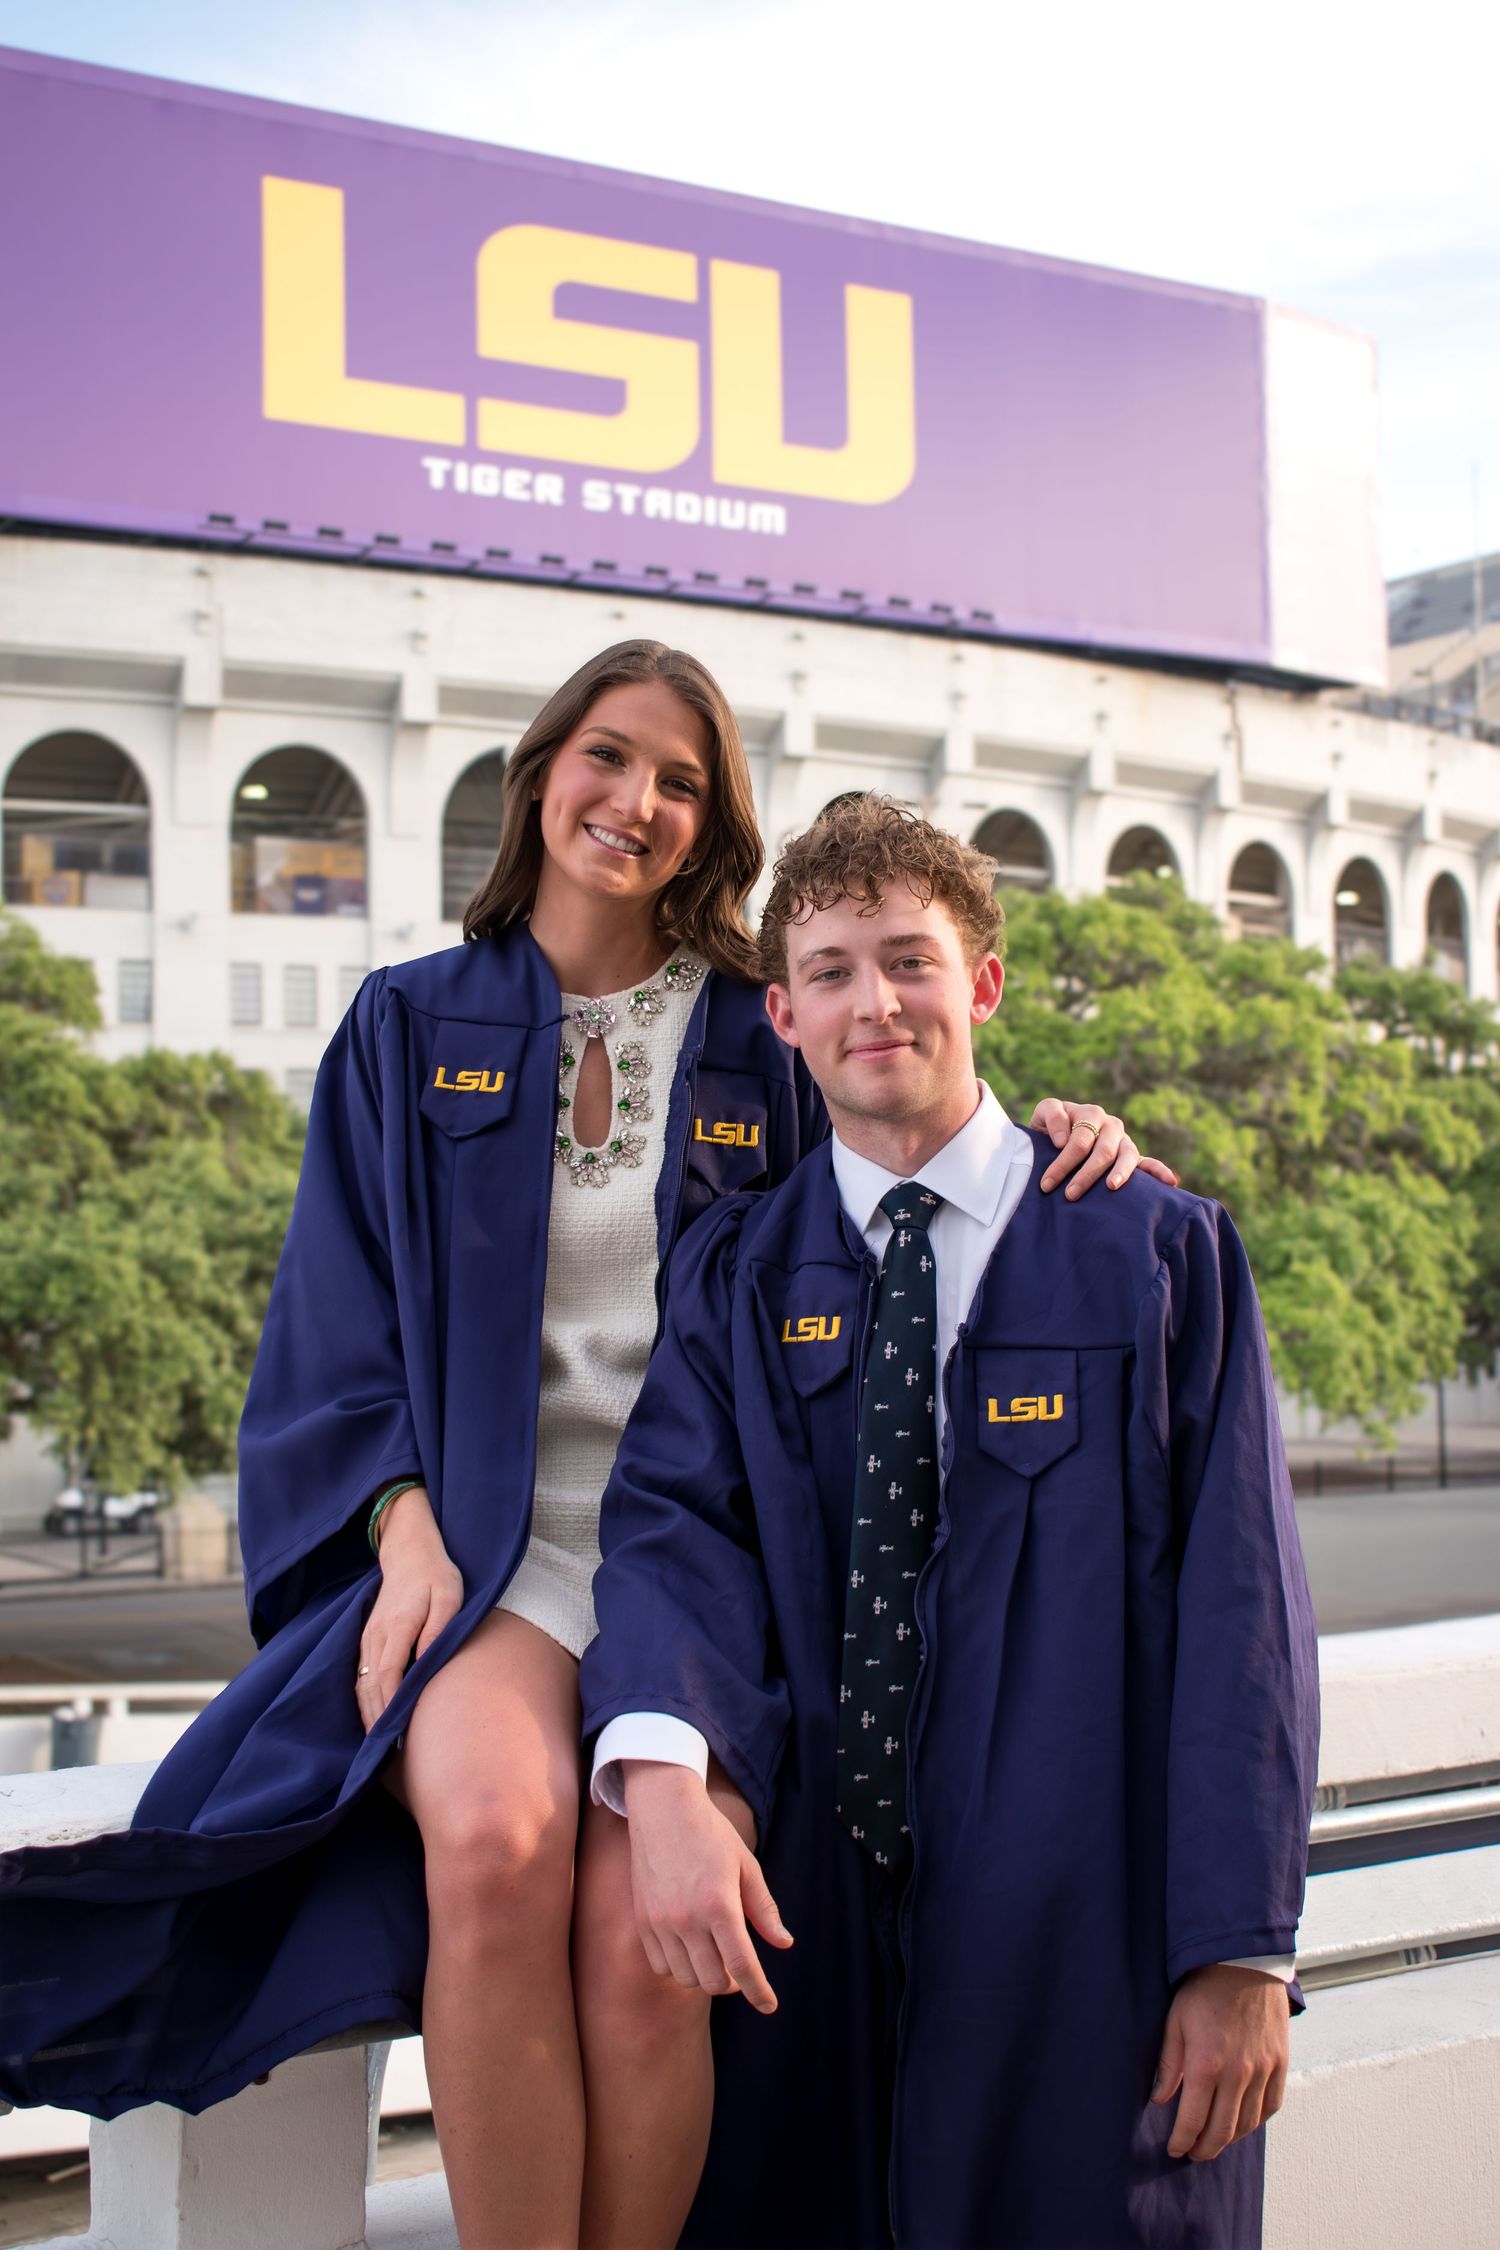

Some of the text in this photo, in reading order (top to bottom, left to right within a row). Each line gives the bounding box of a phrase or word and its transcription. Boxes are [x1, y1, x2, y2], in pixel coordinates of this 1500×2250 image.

[261, 175, 916, 505] LSU
[421, 456, 787, 535] TIGER STADIUM
[434, 1067, 505, 1093] LSU
[695, 1119, 759, 1147] LSU
[782, 1316, 841, 1343] LSU
[988, 1394, 1064, 1423] LSU
